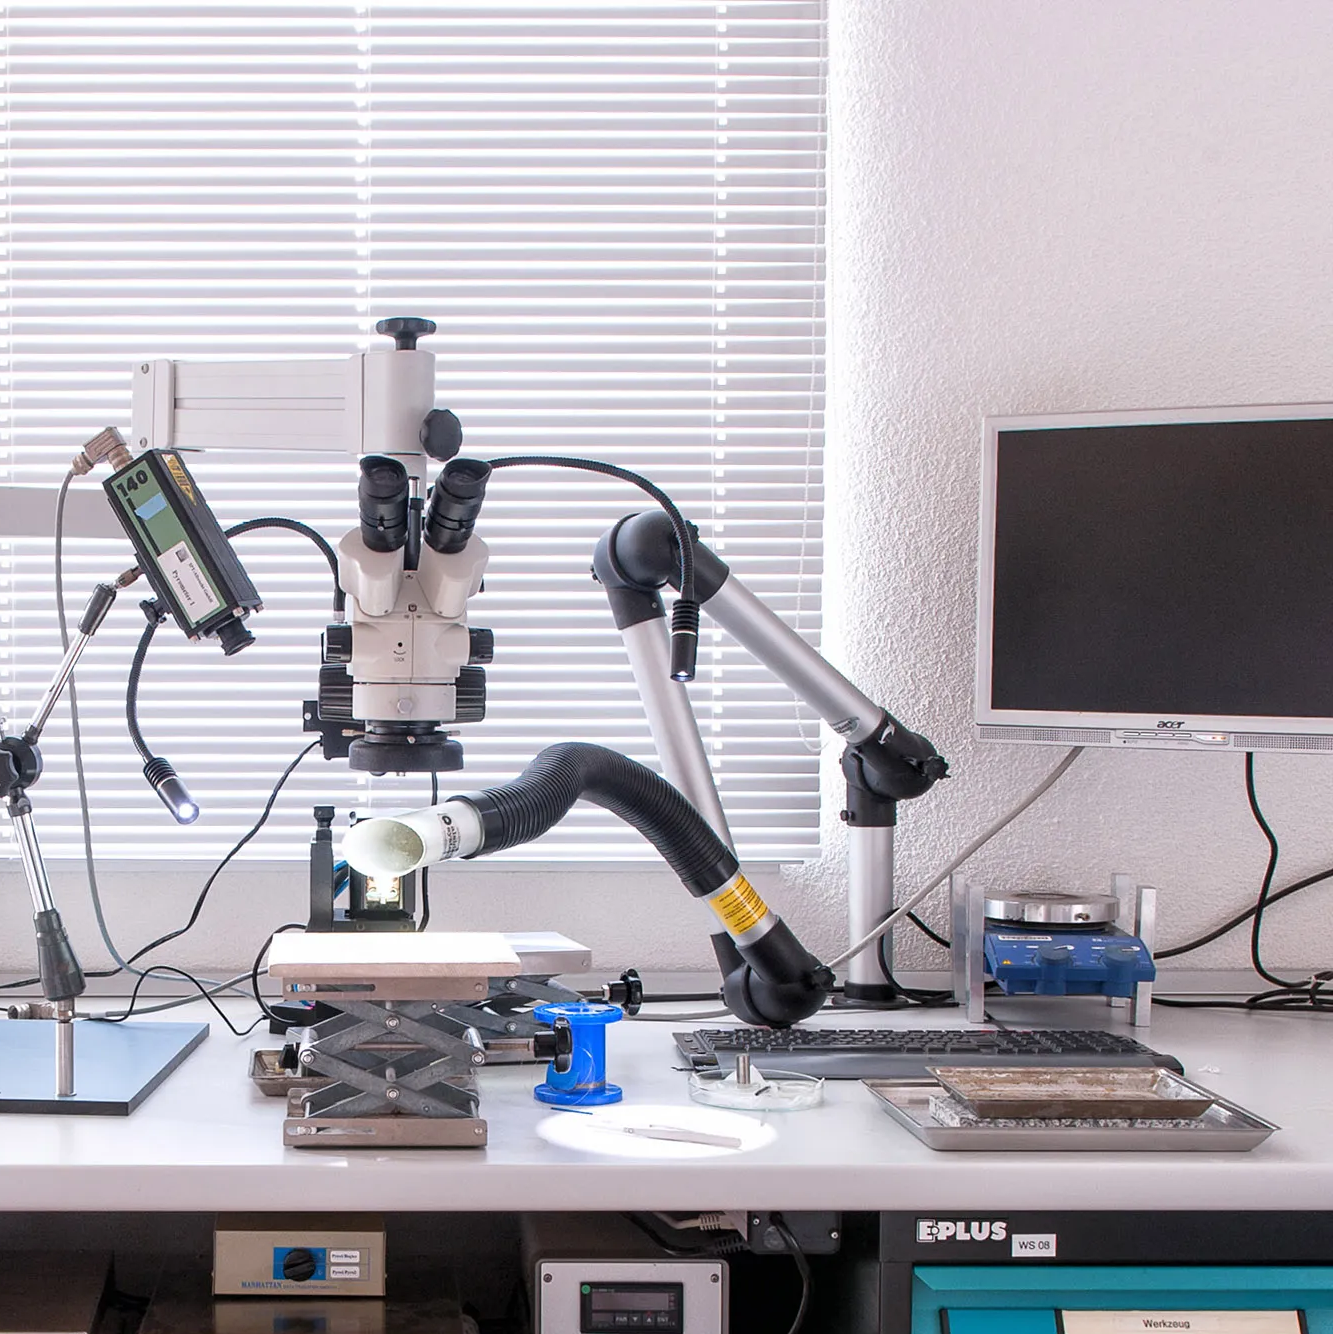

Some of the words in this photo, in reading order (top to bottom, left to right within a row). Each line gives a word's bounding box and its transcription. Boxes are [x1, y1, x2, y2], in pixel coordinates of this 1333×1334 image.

[116, 469, 149, 498] 140
[1156, 720, 1185, 729] acer
[1018, 1240, 1036, 1250] WS
[1037, 1240, 1050, 1250] 08
[241, 1281, 282, 1289] MANHATTAN
[1142, 1319, 1191, 1330] Werkzeug
